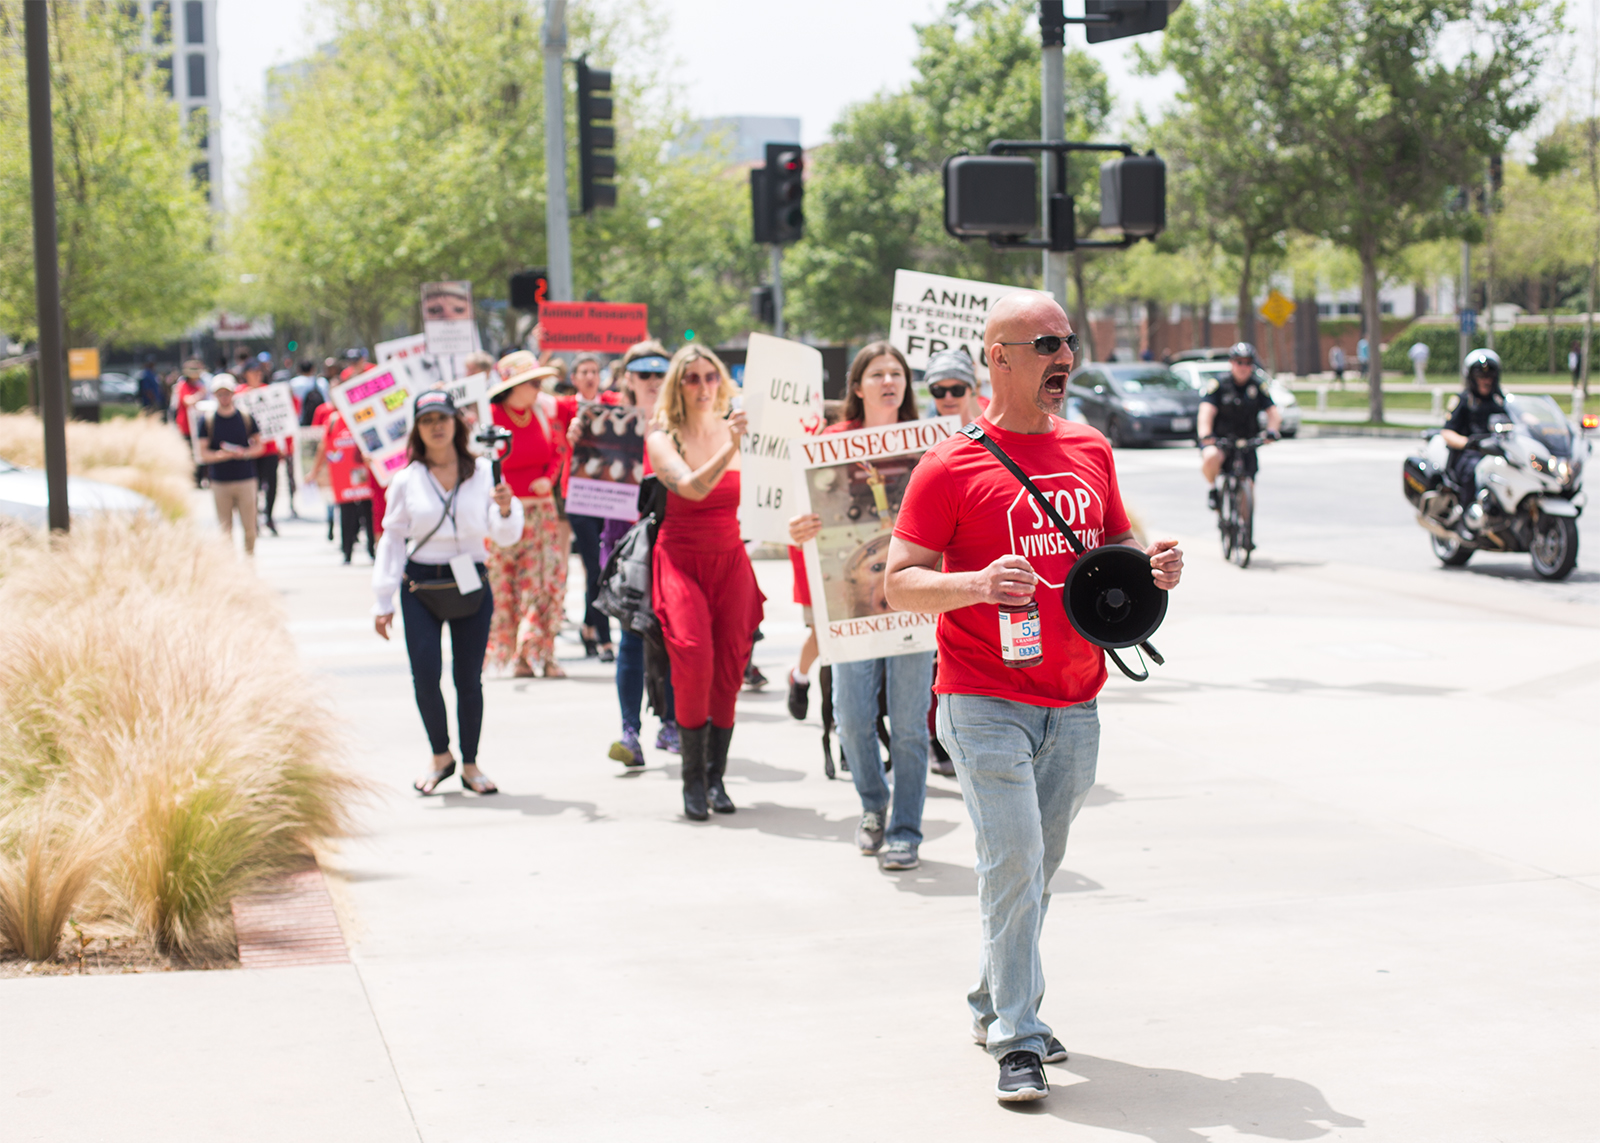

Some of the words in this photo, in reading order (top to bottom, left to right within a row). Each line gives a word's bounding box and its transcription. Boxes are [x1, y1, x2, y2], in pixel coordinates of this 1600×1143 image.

[534, 278, 548, 304] 2
[921, 288, 1001, 312] ANIM
[542, 307, 583, 319] Animal
[588, 307, 644, 320] Research
[900, 318, 917, 331] IS
[544, 331, 604, 344] Scientific
[606, 331, 643, 345] Fraud
[770, 378, 810, 406] UCLA
[802, 421, 951, 464] VIVISECTION
[757, 485, 783, 509] LAB
[1027, 488, 1091, 530] STOP
[829, 614, 896, 639] SCIENCE
[1022, 621, 1031, 636] 5
